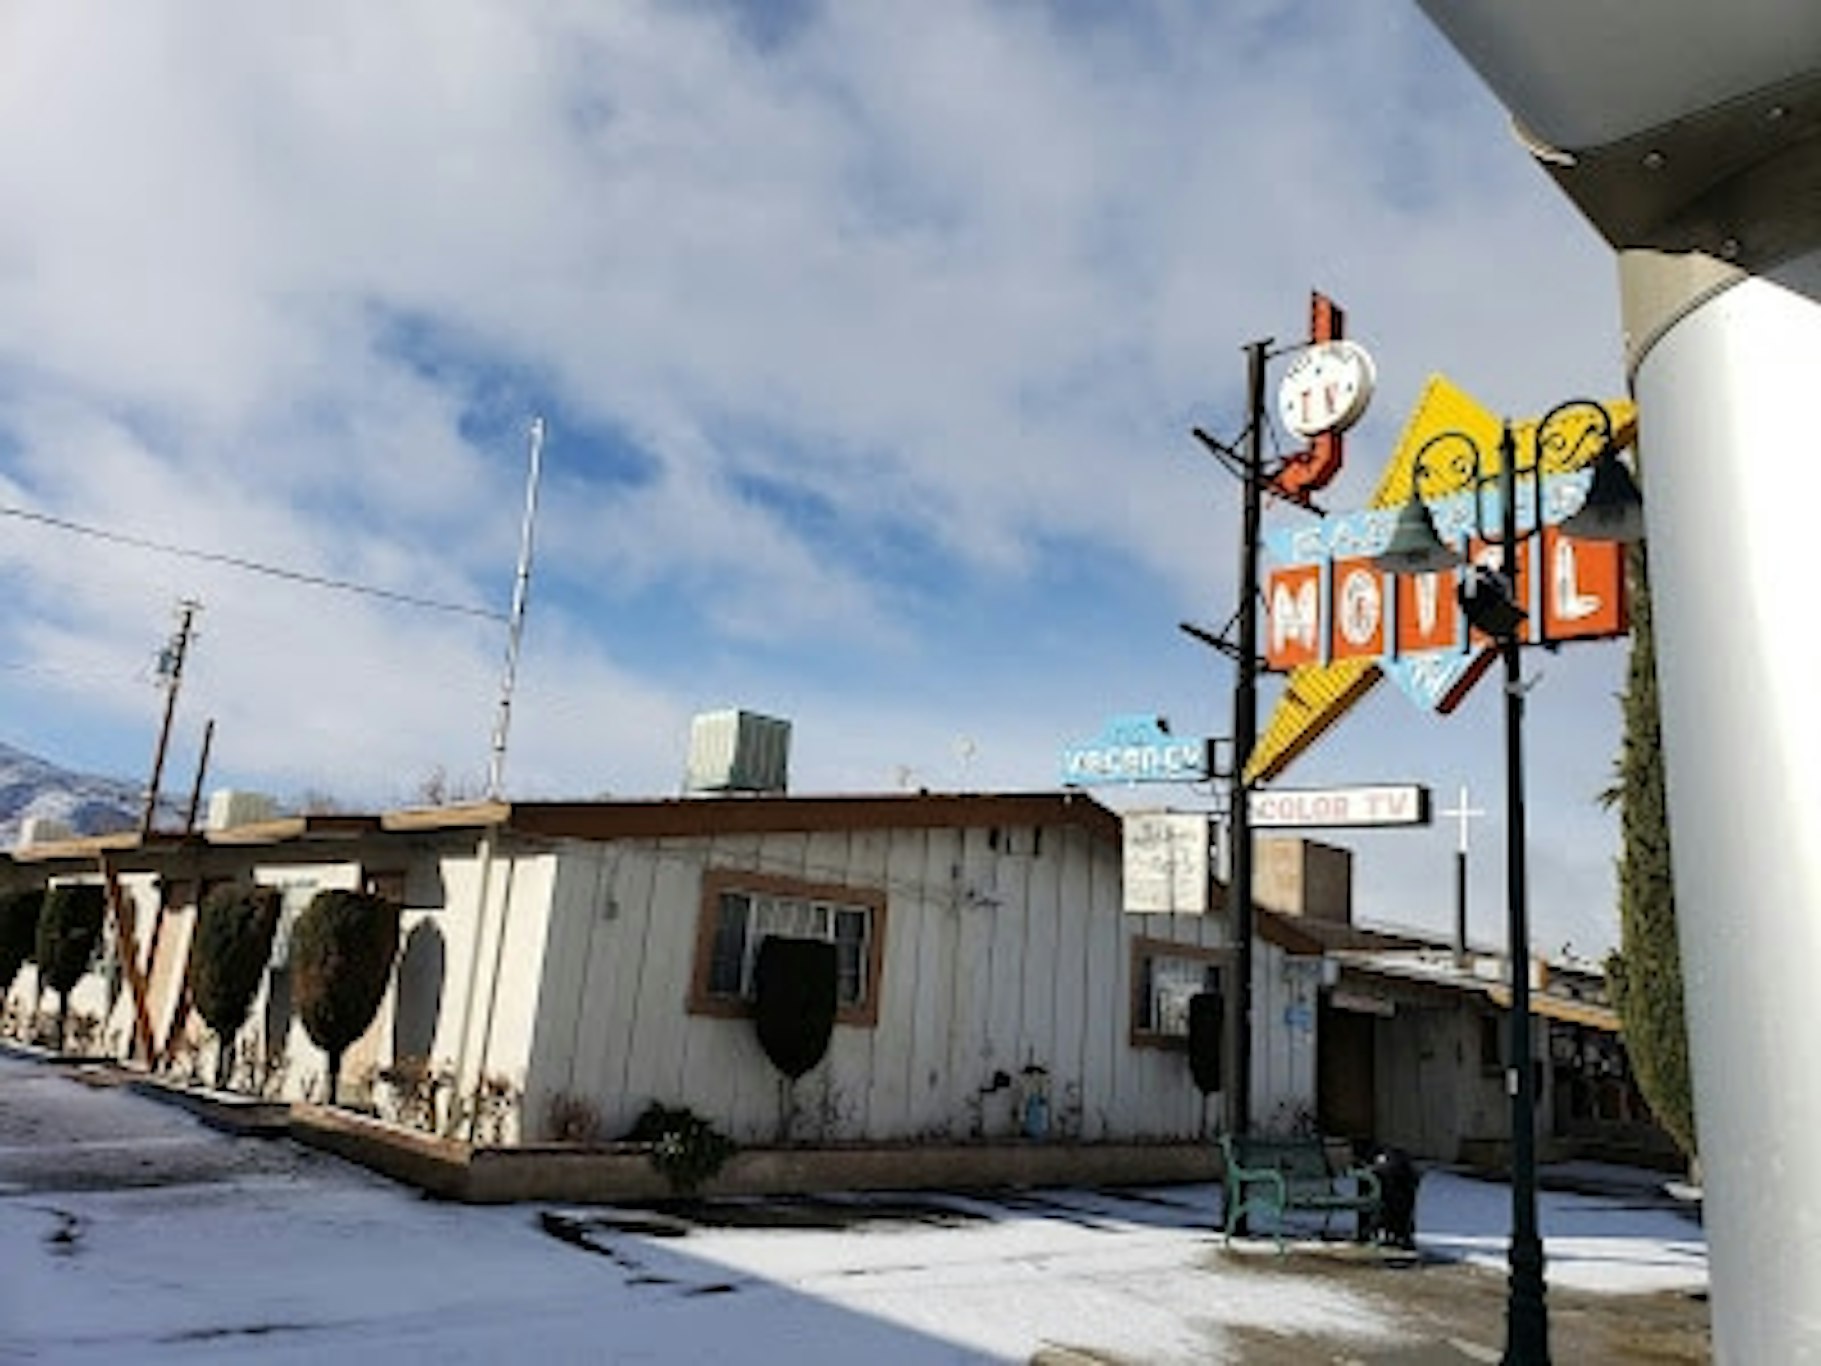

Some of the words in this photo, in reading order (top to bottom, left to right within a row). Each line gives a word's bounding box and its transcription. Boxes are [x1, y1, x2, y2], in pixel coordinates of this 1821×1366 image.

[1271, 536, 1603, 656] MOTL
[1256, 796, 1349, 820] COLOR
[1366, 791, 1409, 816] TV
